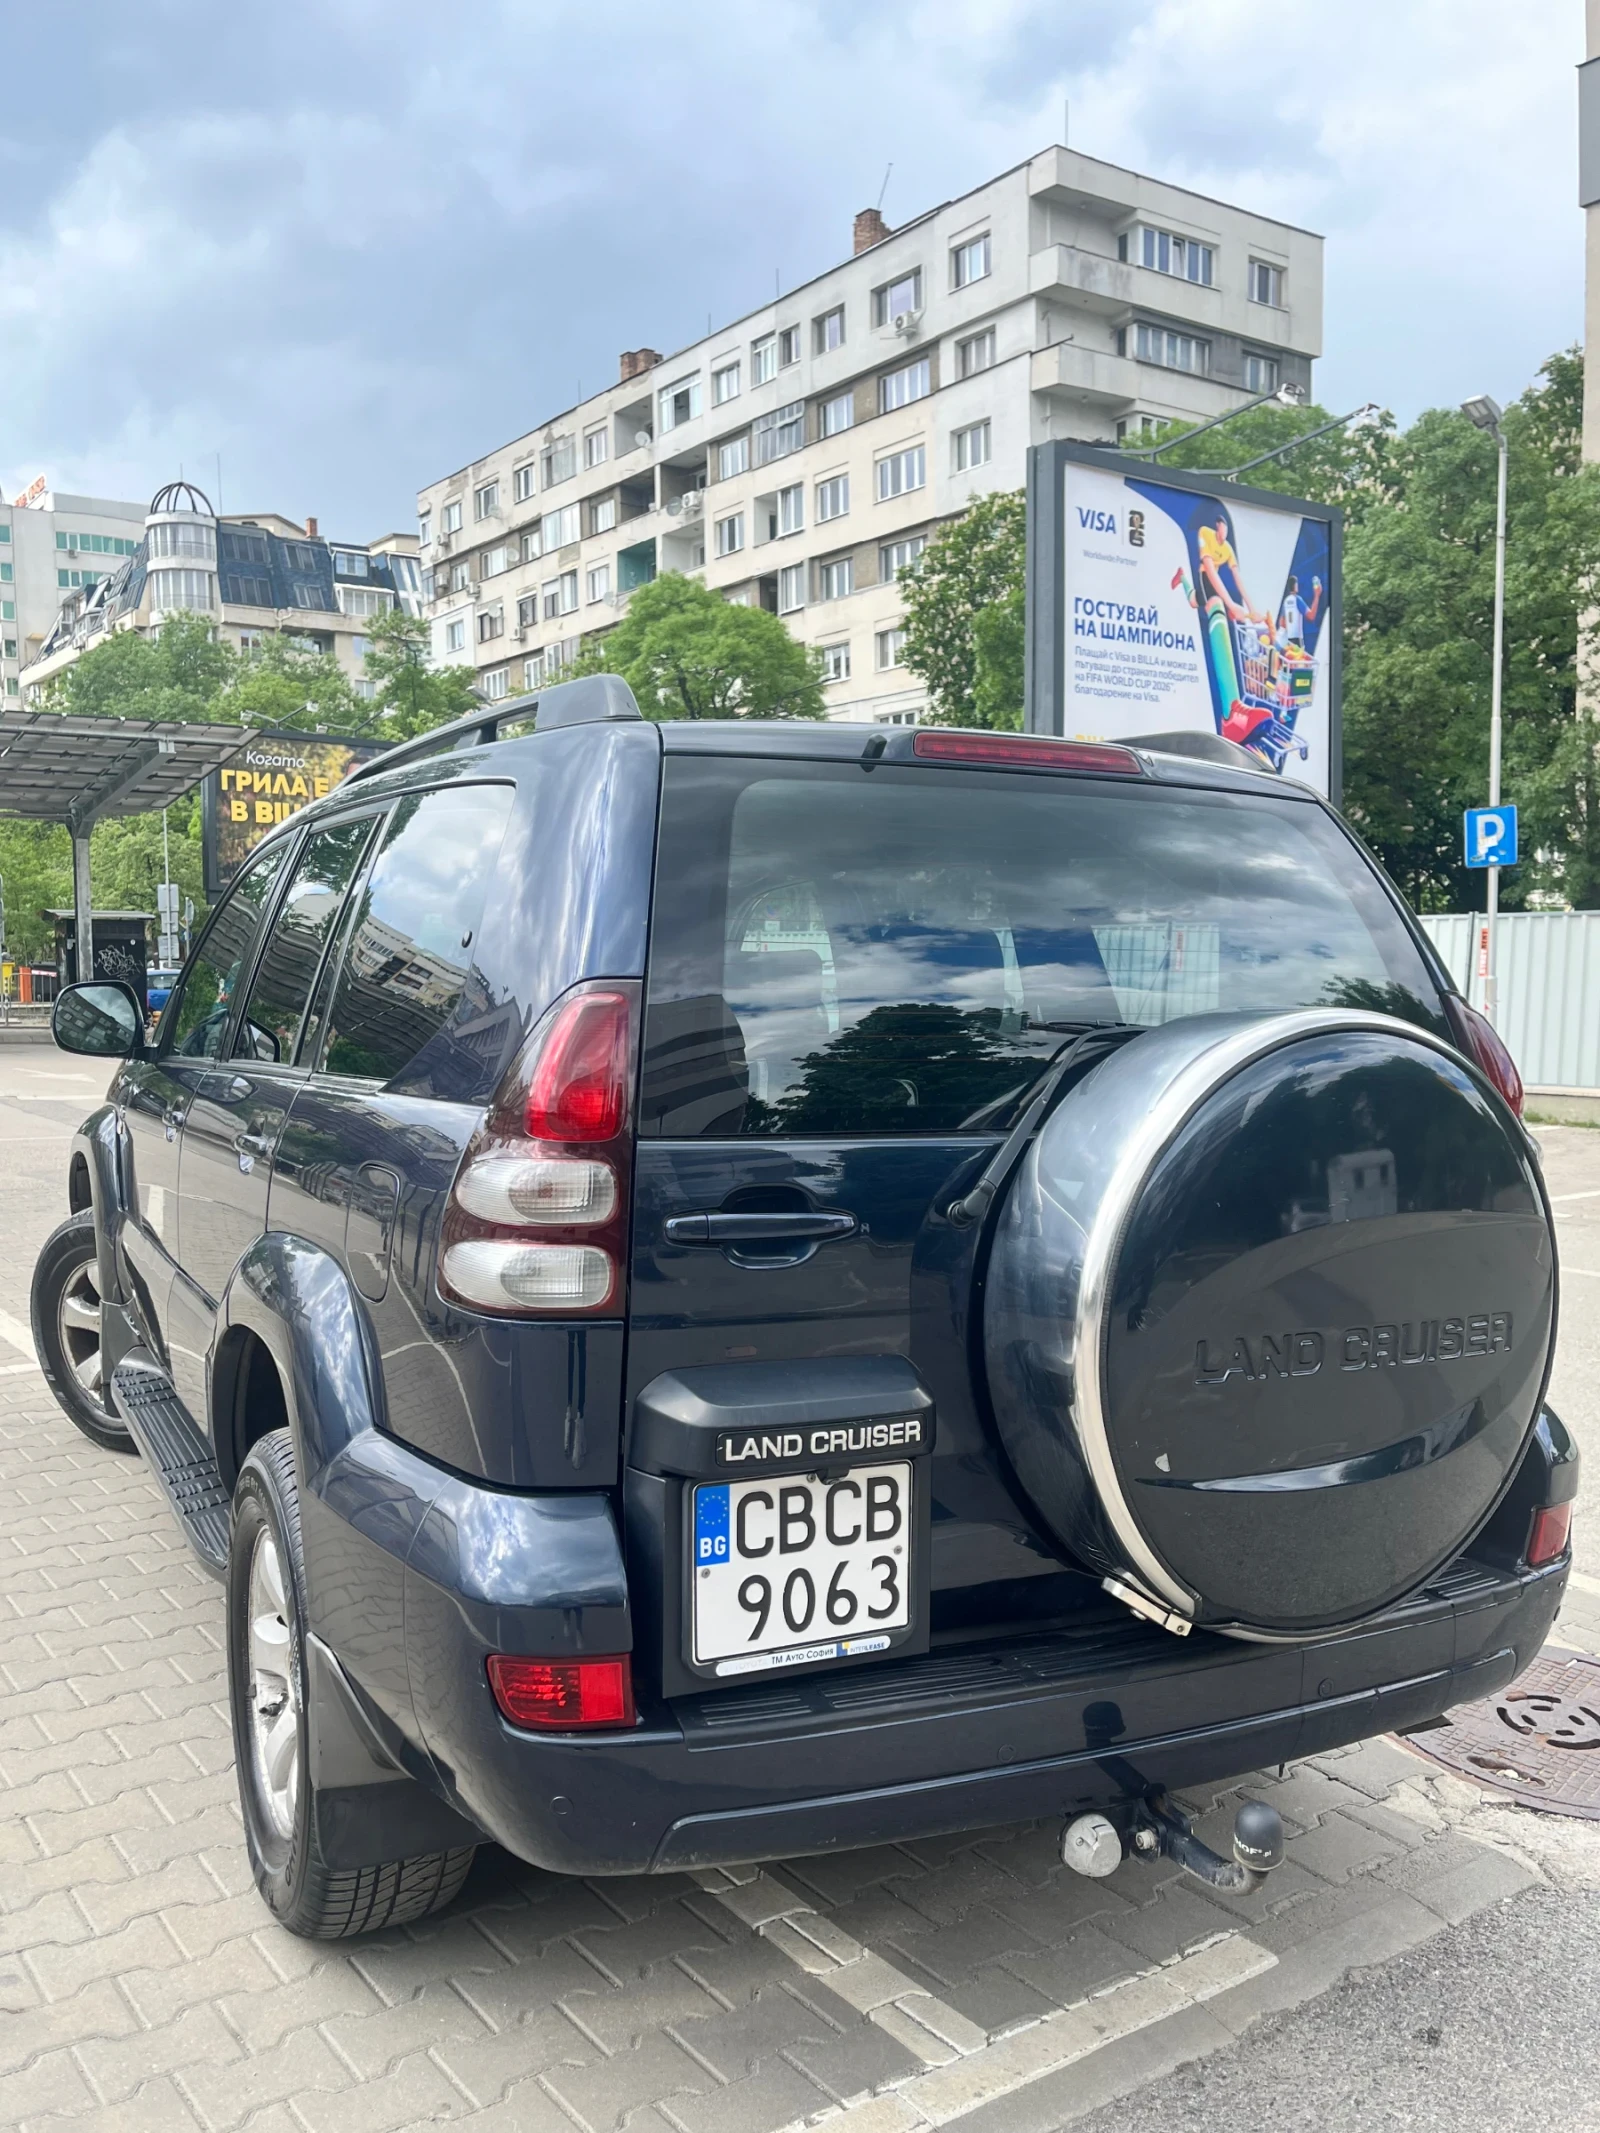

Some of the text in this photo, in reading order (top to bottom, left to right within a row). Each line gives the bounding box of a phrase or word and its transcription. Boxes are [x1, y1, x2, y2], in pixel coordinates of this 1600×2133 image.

[1075, 506, 1117, 534] VISA
[1074, 597, 1158, 626] ГОСТУВАЙ
[1075, 618, 1196, 652] НА ШАМПИОНА
[1074, 660, 1199, 683] пътуваш до страната победител
[1075, 645, 1108, 659] Плащай
[1114, 651, 1130, 662] Visa
[1137, 654, 1159, 666] BILLA
[1167, 660, 1188, 670] може
[1188, 663, 1198, 671] да
[1074, 683, 1131, 699] благодарение
[1133, 692, 1142, 701] на
[1075, 673, 1085, 681] на
[1086, 672, 1102, 684] FIFA
[1104, 674, 1134, 687] WORLD
[1135, 679, 1151, 689] CUP
[246, 750, 305, 768] Когато
[220, 769, 308, 797] ГРИЛА
[230, 800, 249, 822] В
[1476, 814, 1505, 860] P
[1194, 1311, 1514, 1386] LAND CRUISER
[725, 1420, 921, 1462] LAND CRUISER
[700, 1535, 727, 1558] BG
[737, 1555, 900, 1642] 9063
[806, 1648, 834, 1659] София
